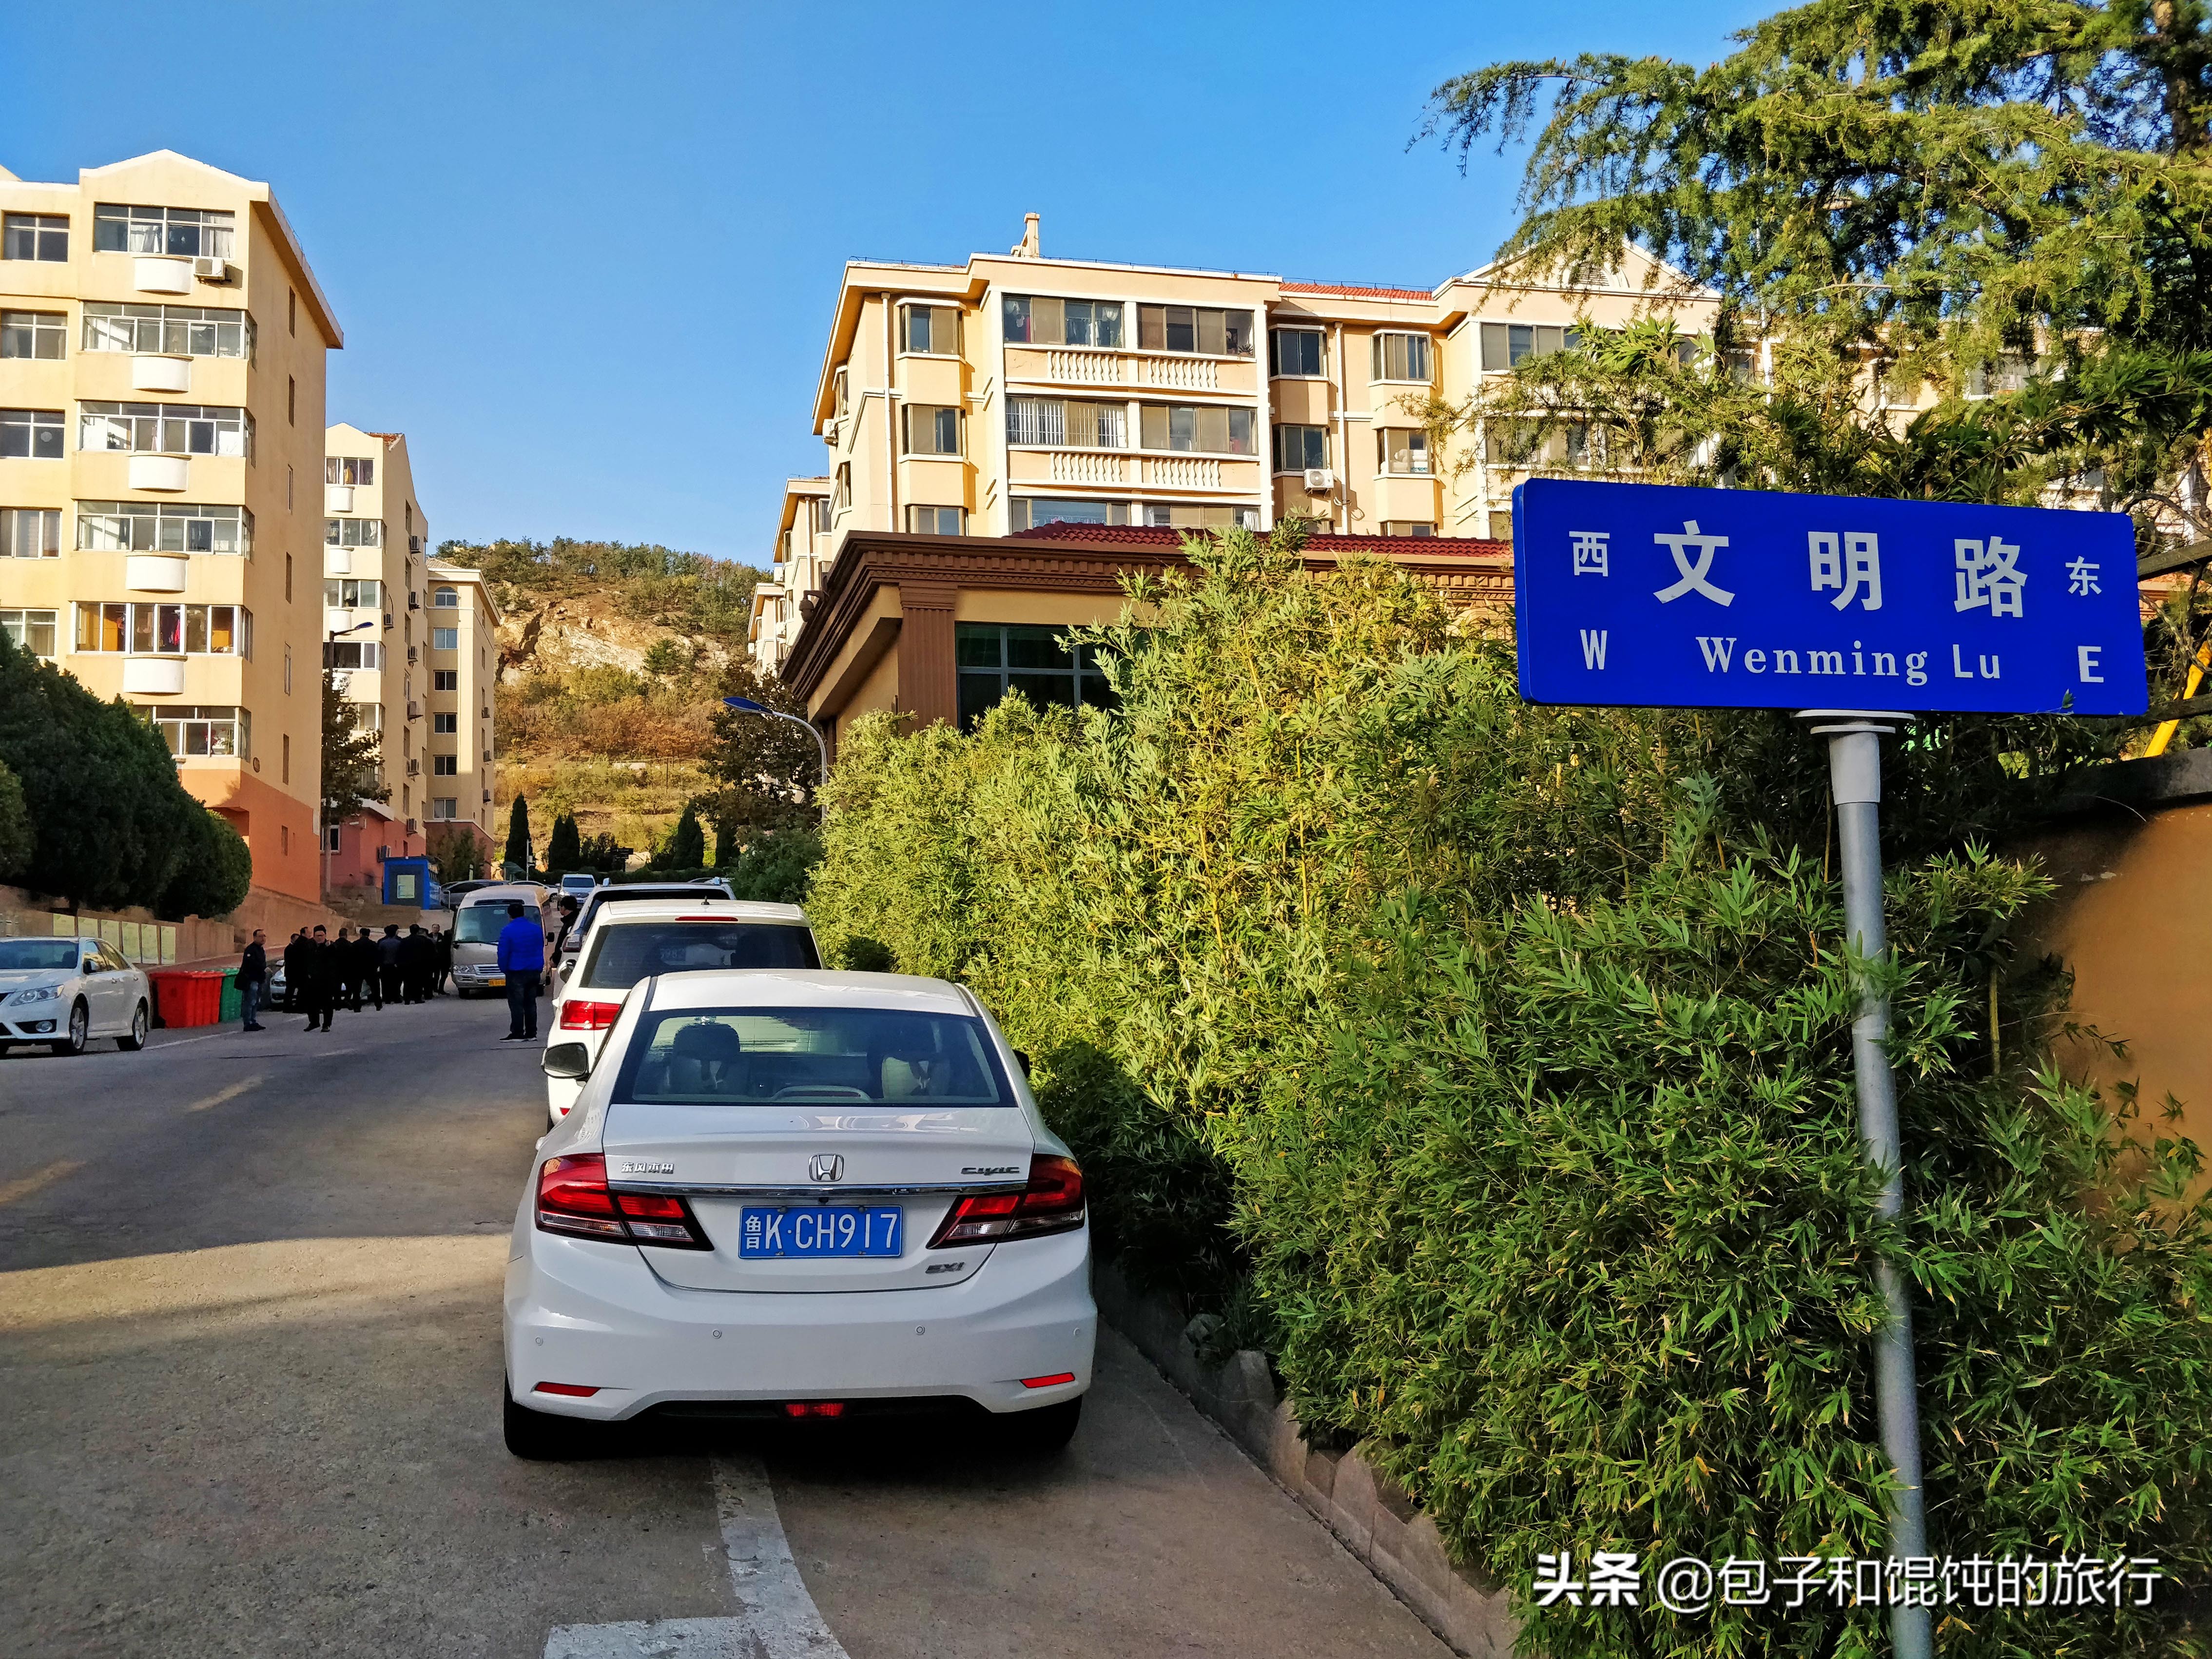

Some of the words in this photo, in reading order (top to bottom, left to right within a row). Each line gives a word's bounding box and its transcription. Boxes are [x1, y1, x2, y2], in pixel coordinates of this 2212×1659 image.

[1569, 531, 1610, 577] 西
[1653, 520, 2028, 618] 文明路
[2065, 556, 2102, 596] 东
[1580, 629, 1608, 670] W
[1695, 637, 1927, 686] Wenming
[1953, 644, 2000, 679] Lu
[2077, 645, 2104, 683] E
[621, 1162, 674, 1174] 东风本田
